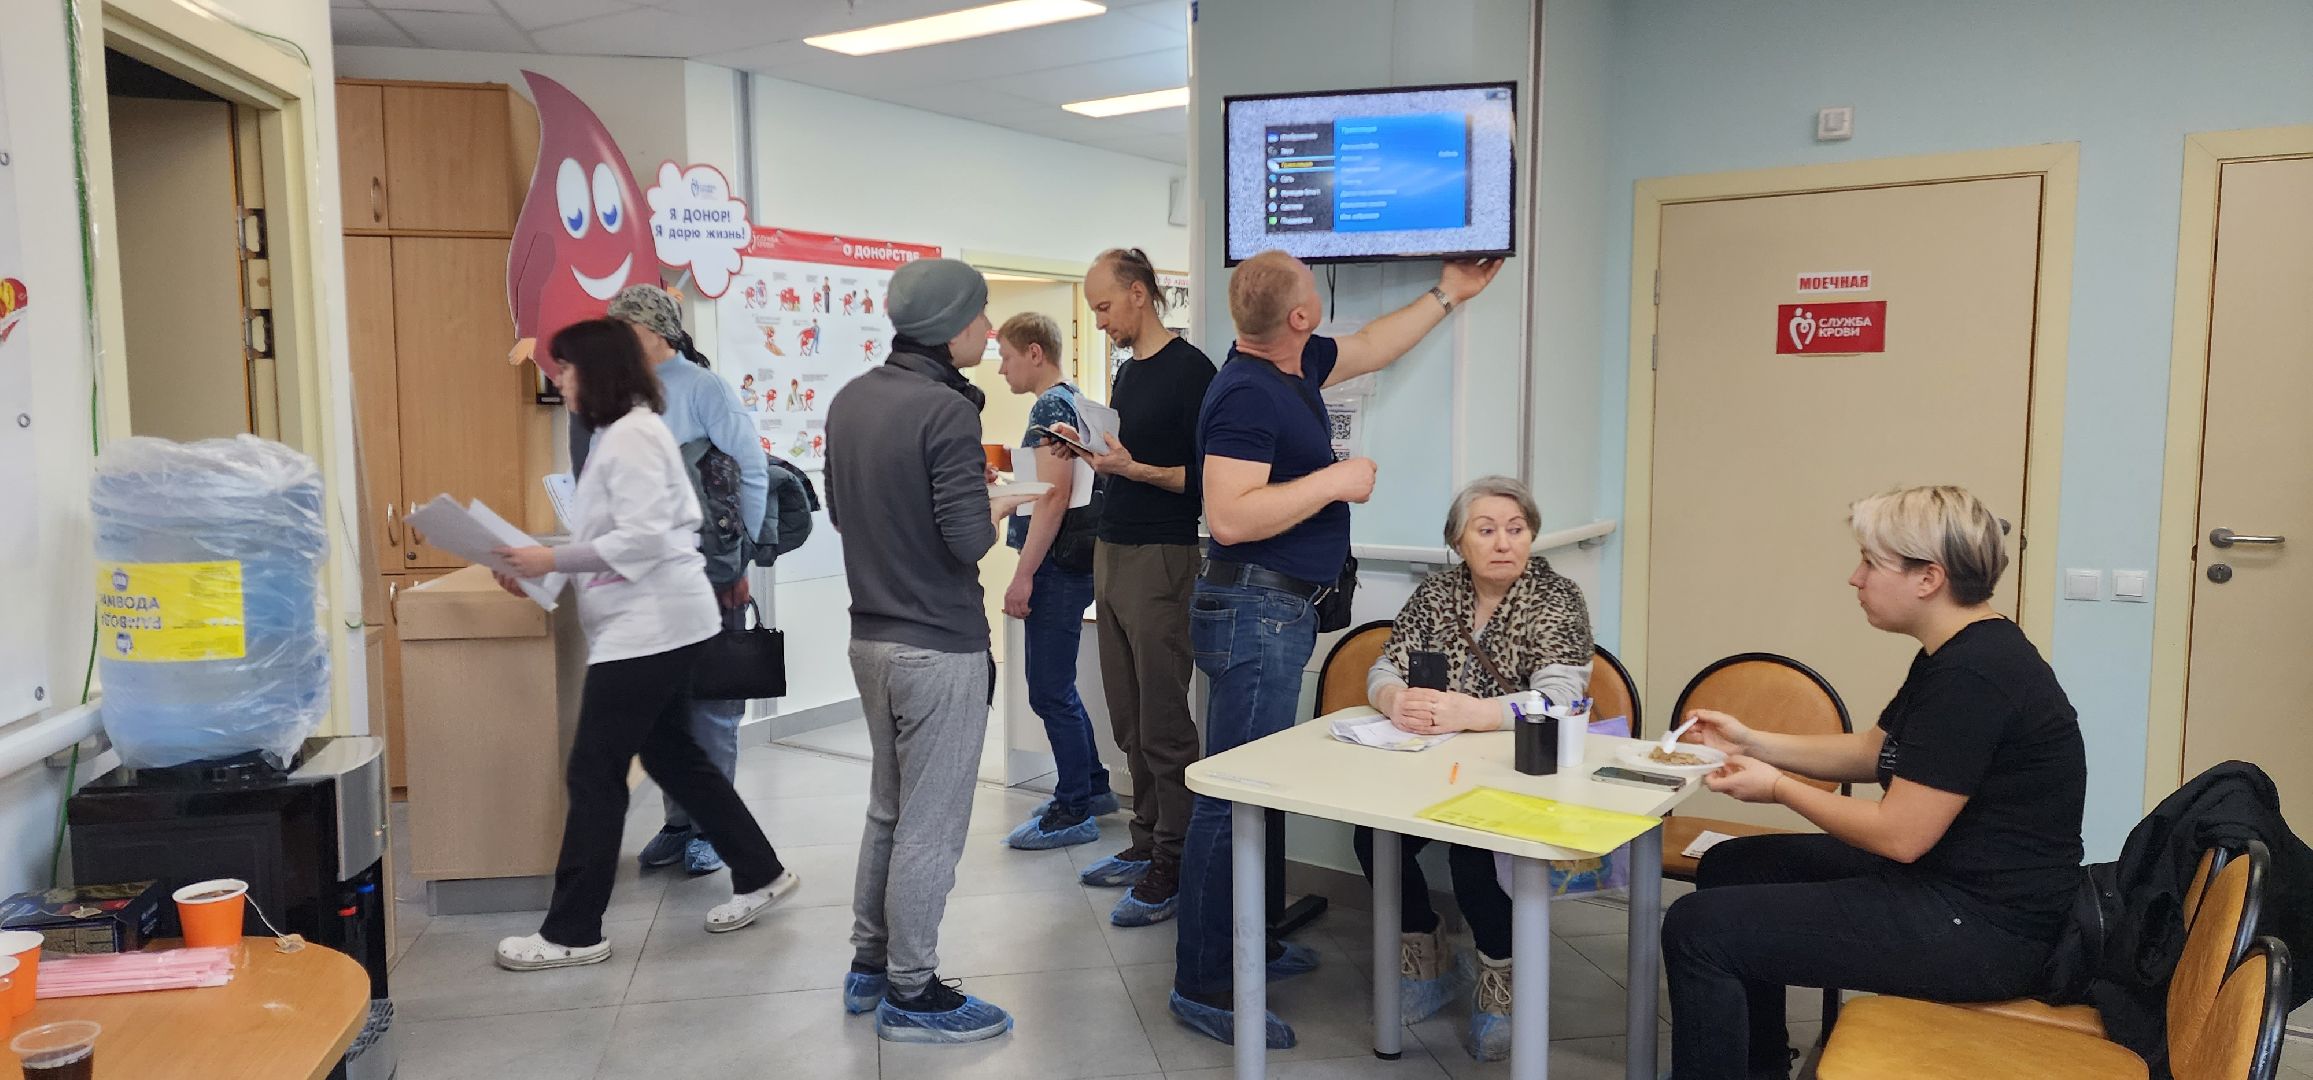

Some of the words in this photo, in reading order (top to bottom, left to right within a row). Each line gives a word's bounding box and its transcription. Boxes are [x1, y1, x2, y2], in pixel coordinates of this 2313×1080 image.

[669, 207, 677, 221] Я
[683, 207, 731, 224] ДОНОР!
[655, 224, 663, 237] Я
[668, 228, 701, 241] дарю
[706, 227, 745, 240] жизнь!
[842, 243, 852, 257] О
[1799, 275, 1868, 290] МОЕЧНАЯ
[1819, 317, 1872, 327] СЛУЖБА
[1818, 327, 1861, 338] КРОВИ
